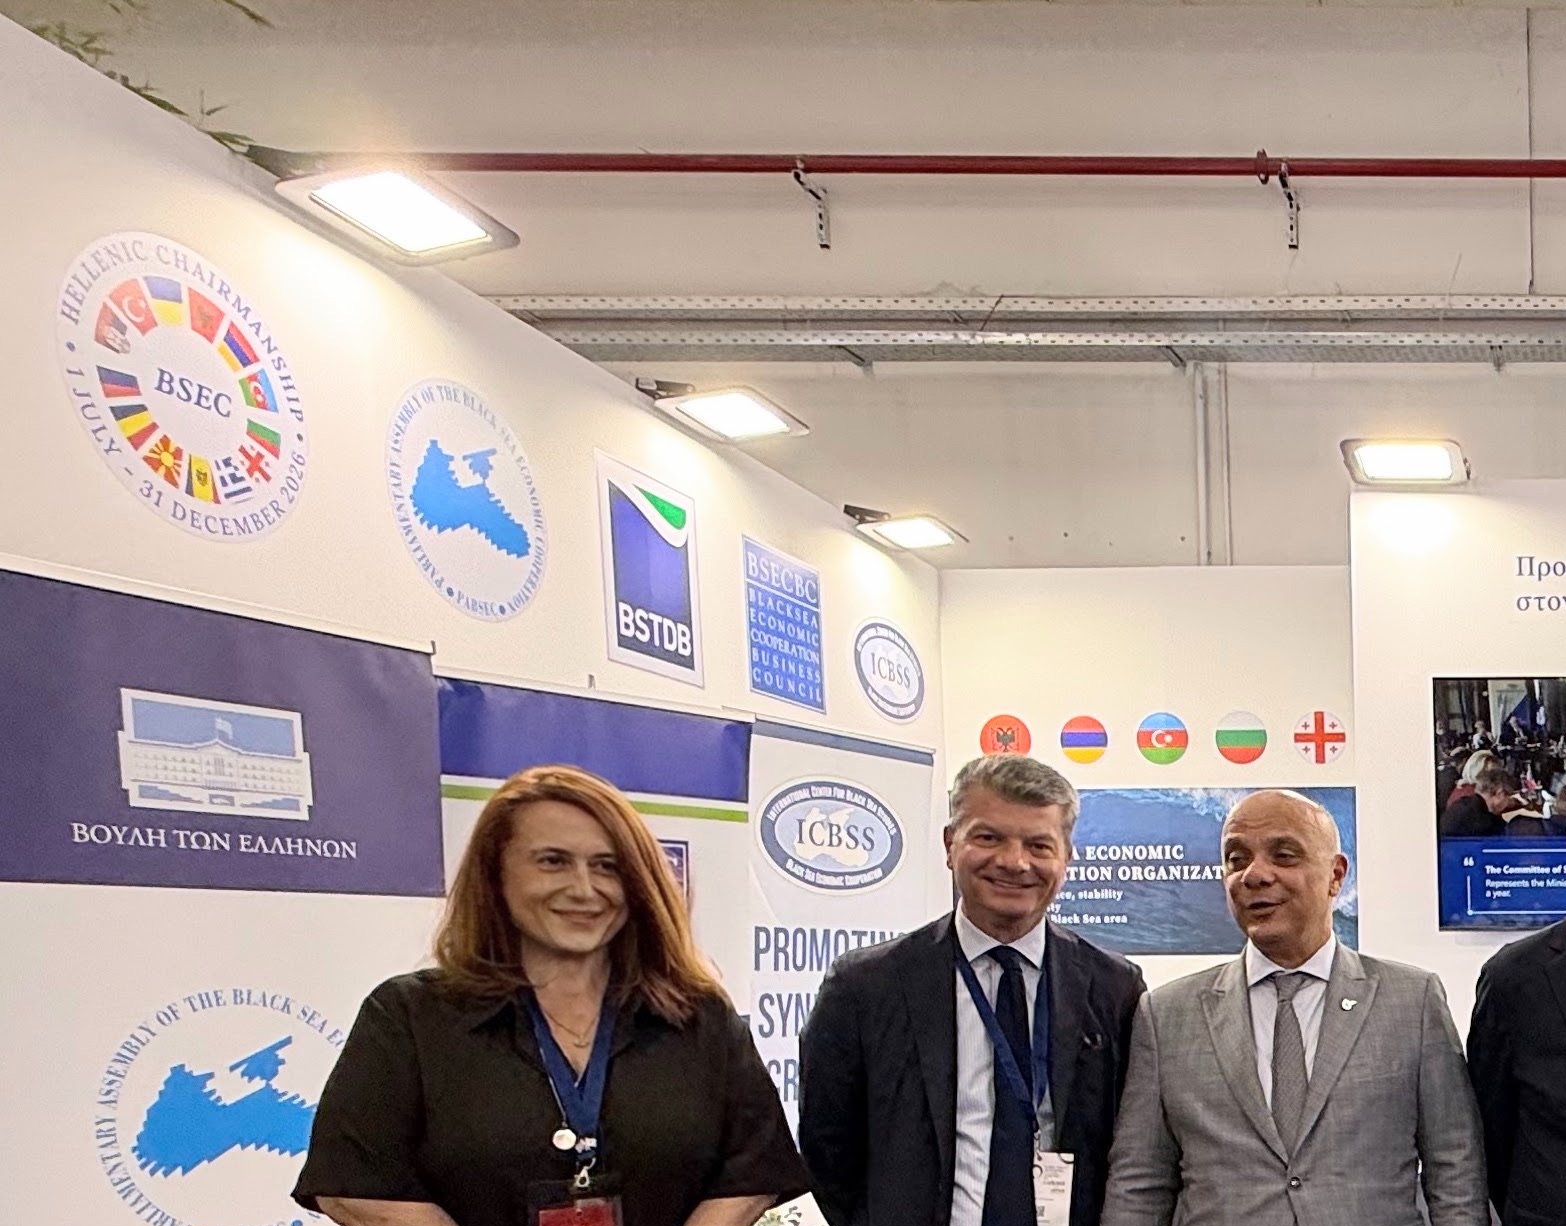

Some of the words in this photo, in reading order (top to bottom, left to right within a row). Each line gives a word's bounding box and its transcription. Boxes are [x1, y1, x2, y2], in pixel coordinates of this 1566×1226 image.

[61, 240, 148, 325] HELLENIC
[156, 244, 304, 422] CHAIRMANSHIP
[66, 366, 84, 377] 1
[154, 368, 232, 418] BSEC
[436, 385, 462, 404] THE
[72, 387, 121, 456] JULY
[140, 480, 163, 507] 31
[279, 451, 306, 504] 2026
[172, 500, 285, 536] DECEMBER
[747, 551, 817, 604] BSECBC
[456, 590, 499, 617] PABSEC
[618, 601, 692, 657] BSTDB
[750, 608, 819, 647] ECONOMIC
[751, 628, 820, 665] COOPERATION
[752, 647, 821, 684] BUSINESS
[871, 652, 911, 689] ICBSS
[753, 669, 822, 702] COUNCIL
[71, 822, 167, 849] ΒΟΥΛΗ
[172, 829, 231, 852] ΤΩΝ
[239, 834, 358, 859] ΕΛΛΗΝΩΝ
[796, 818, 876, 851] ICBSS
[1085, 845, 1185, 861] ECONOMIC
[1485, 865, 1502, 874] The
[1503, 865, 1550, 874] Committee
[1551, 864, 1562, 874] of
[1065, 866, 1113, 881] TION
[1485, 879, 1530, 889] Represents
[1530, 878, 1545, 887] the
[1078, 889, 1124, 901] stability
[1485, 890, 1492, 898] a
[1082, 914, 1102, 924] Sea
[1104, 916, 1128, 924] area
[97, 1022, 157, 1111] ASSEMBLY
[156, 1003, 185, 1027] OF
[183, 989, 227, 1014] THE
[232, 988, 299, 1015] BLACK
[296, 1005, 331, 1034] SEA
